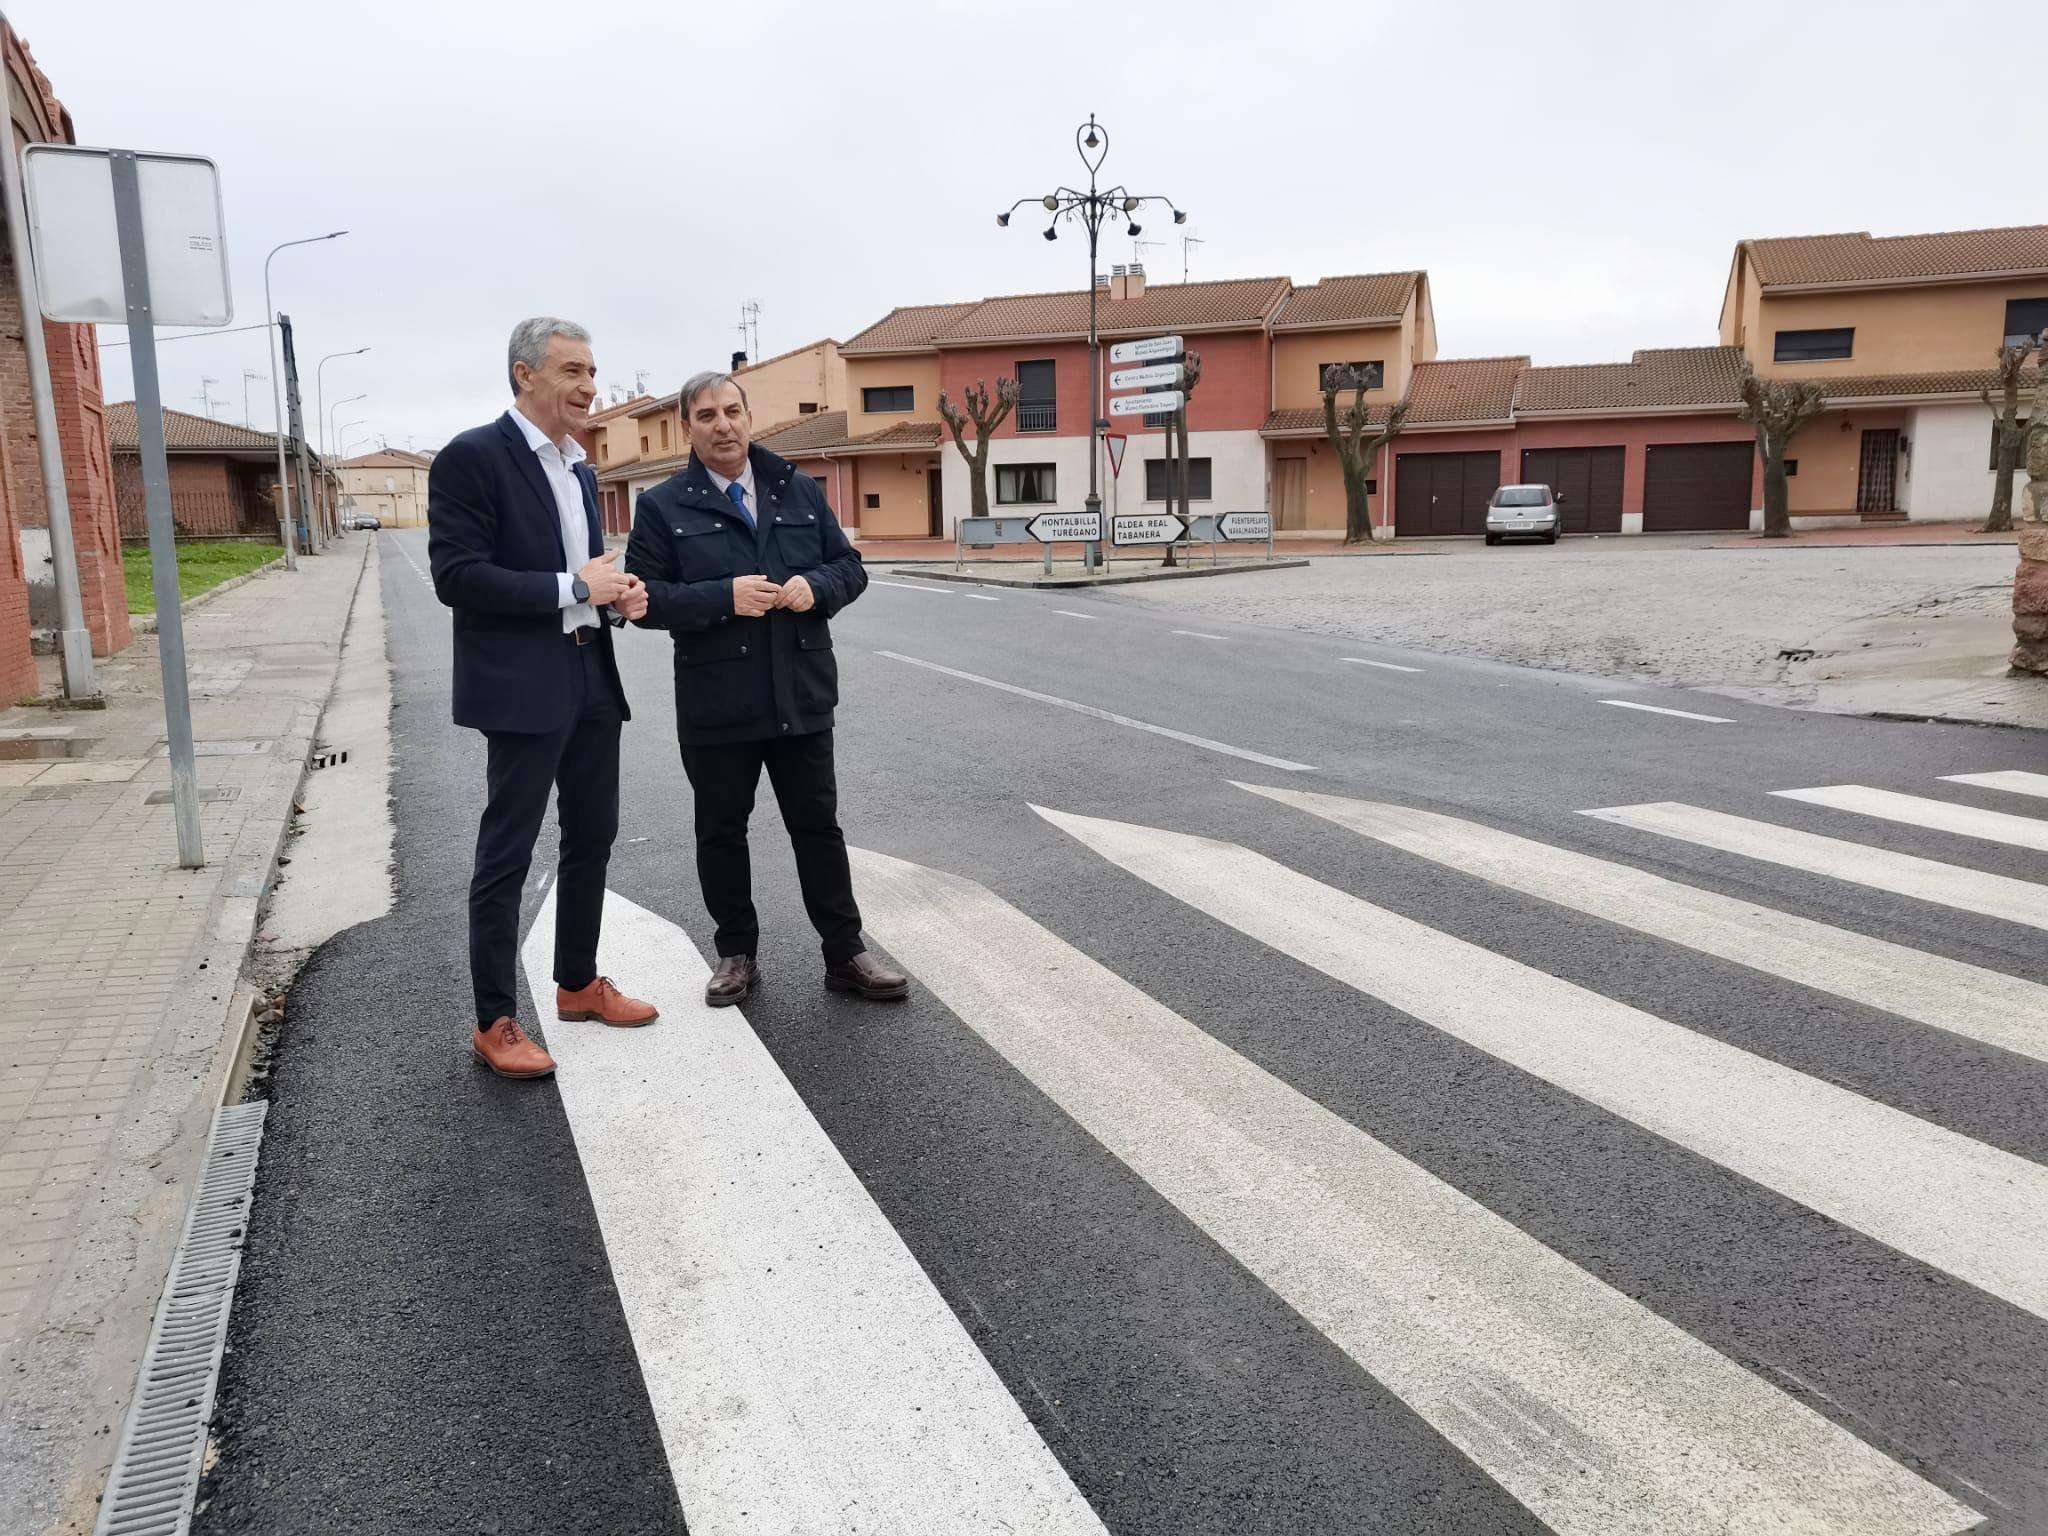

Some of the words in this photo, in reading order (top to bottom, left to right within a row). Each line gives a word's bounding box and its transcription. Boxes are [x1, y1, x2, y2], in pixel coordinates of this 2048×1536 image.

[1041, 516, 1097, 526] HONTALBILLA
[1117, 520, 1143, 529] ALDEA
[1148, 519, 1168, 527] REAL
[1117, 530, 1161, 540] TABANERA
